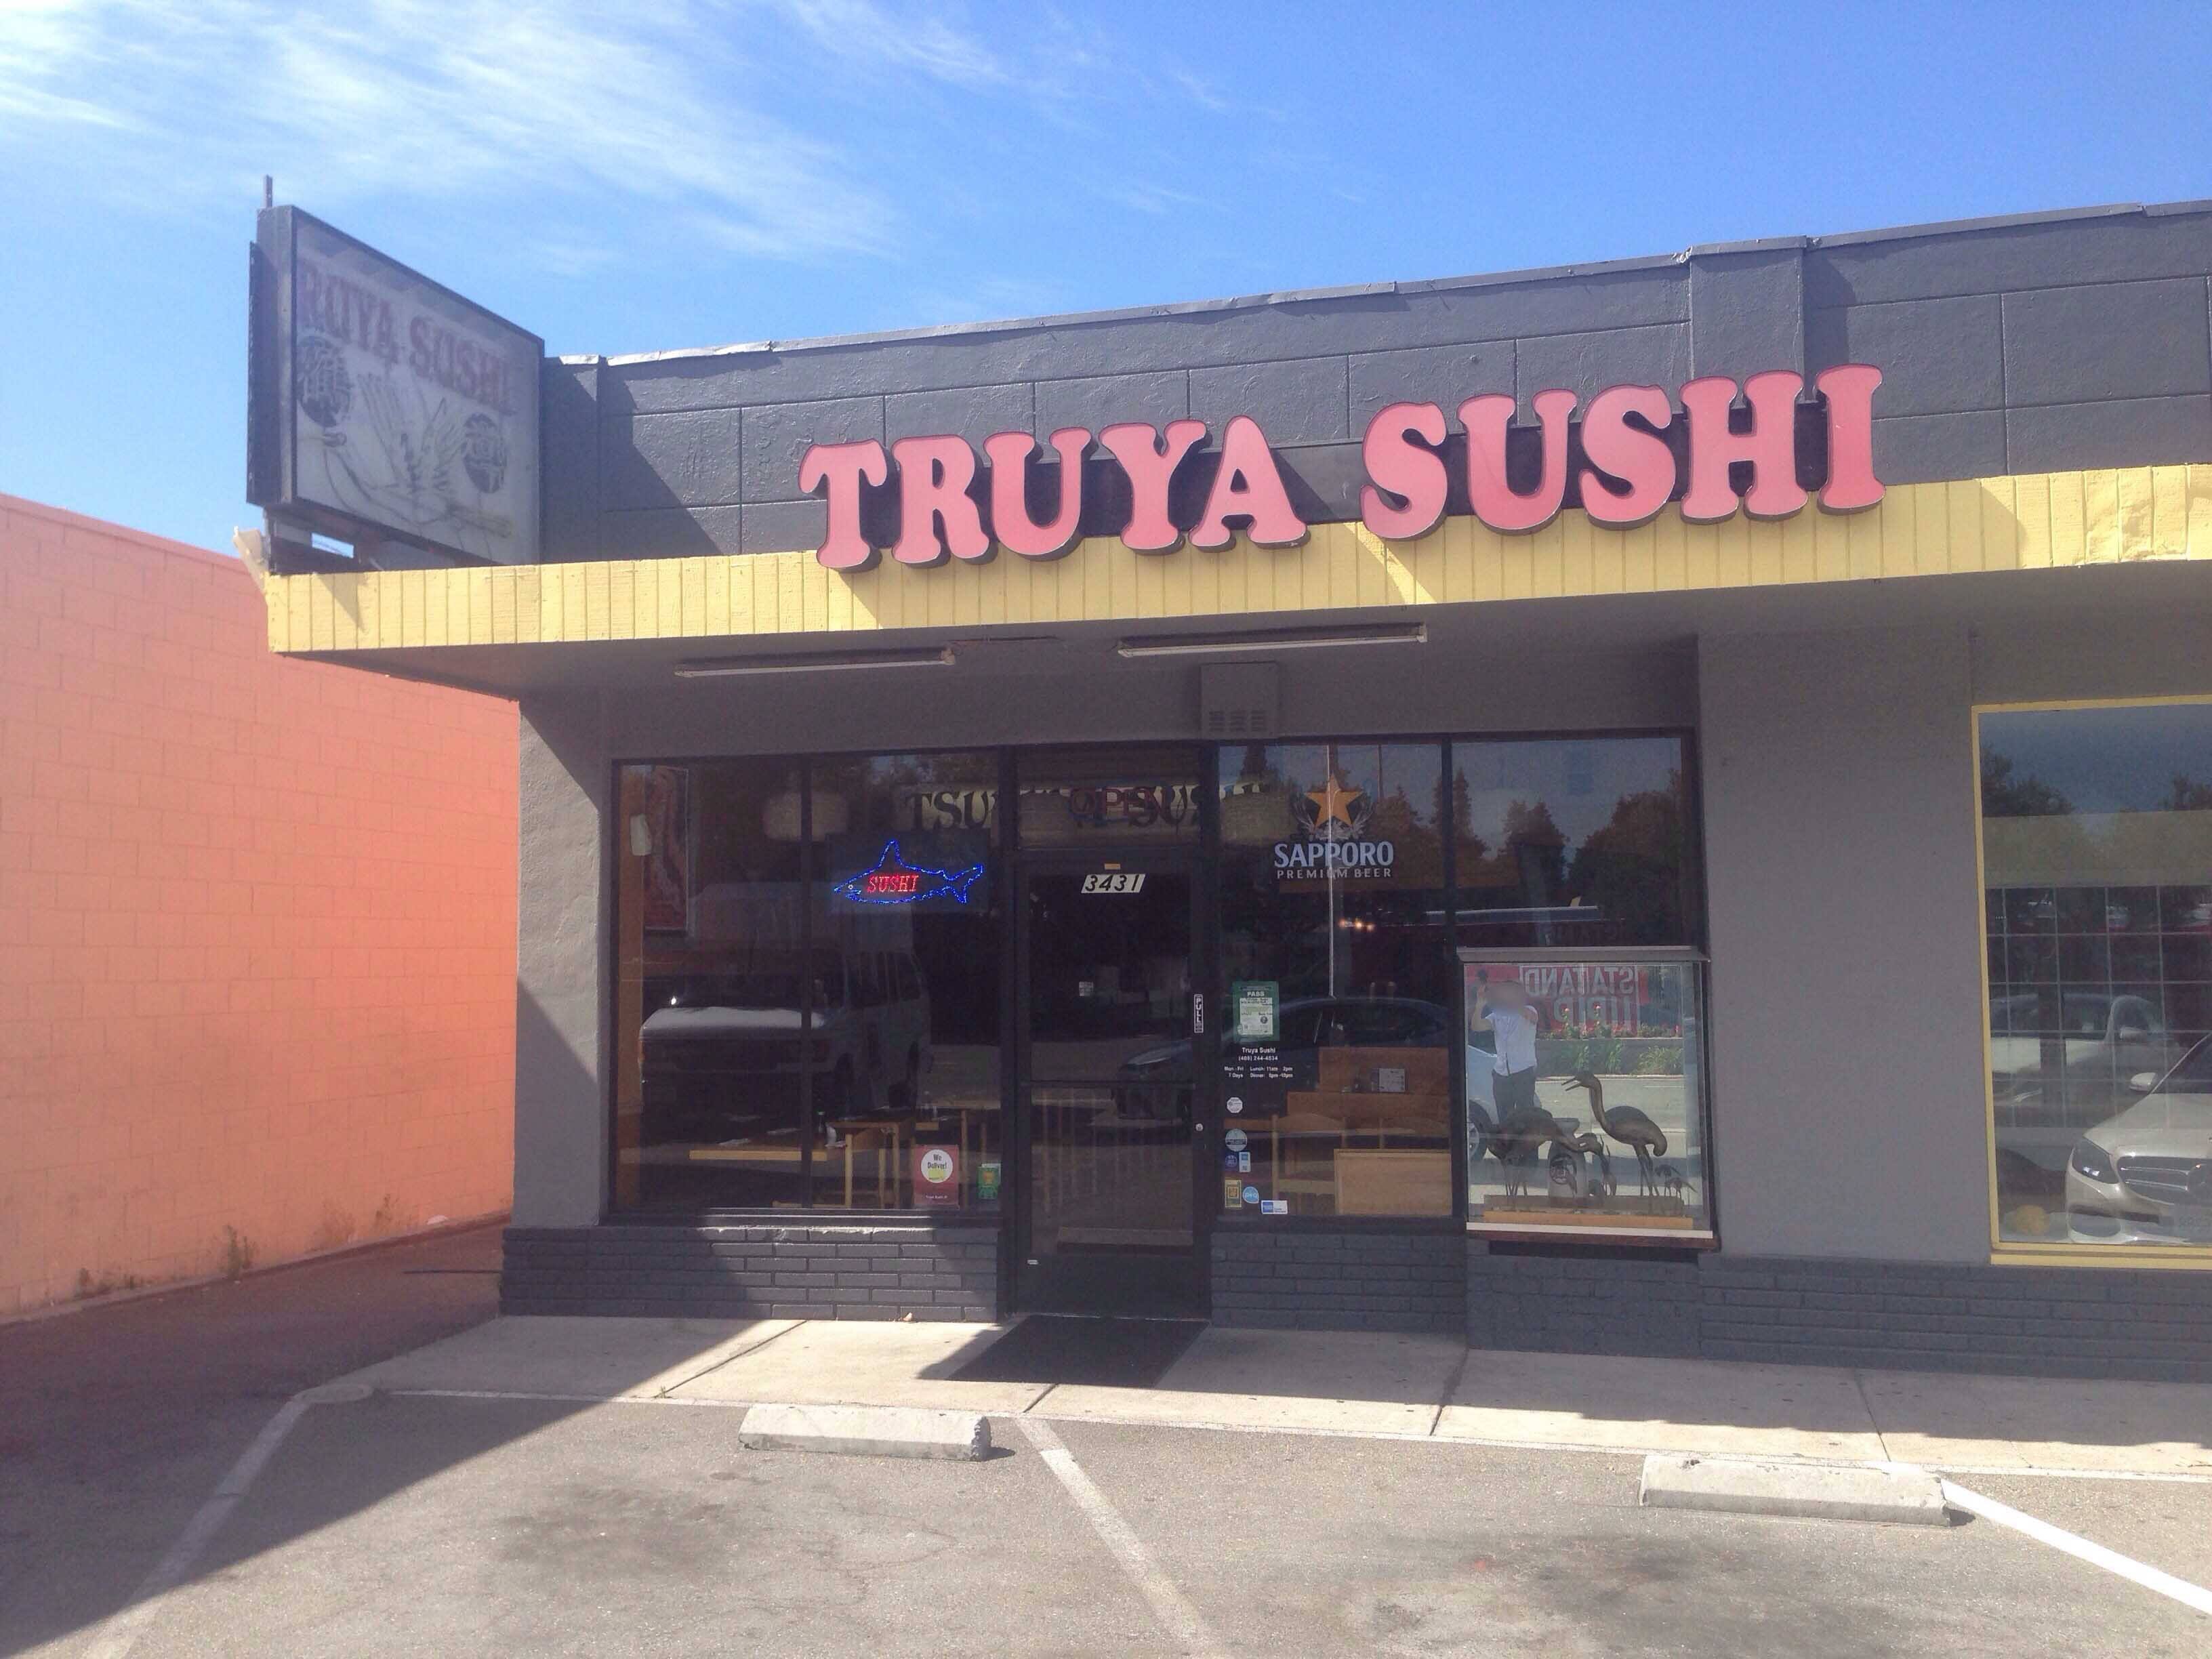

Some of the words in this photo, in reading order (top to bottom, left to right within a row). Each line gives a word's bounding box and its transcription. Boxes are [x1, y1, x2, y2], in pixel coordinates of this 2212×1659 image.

[409, 313, 518, 416] SUSHI
[799, 415, 1309, 570] TRUYA
[1359, 364, 1886, 540] SUSHI
[1274, 841, 1394, 867] SAPPORO
[867, 874, 920, 893] SUSHI
[1084, 875, 1140, 892] 3431
[1277, 869, 1348, 879] PREMIUM
[1355, 868, 1391, 878] BEER
